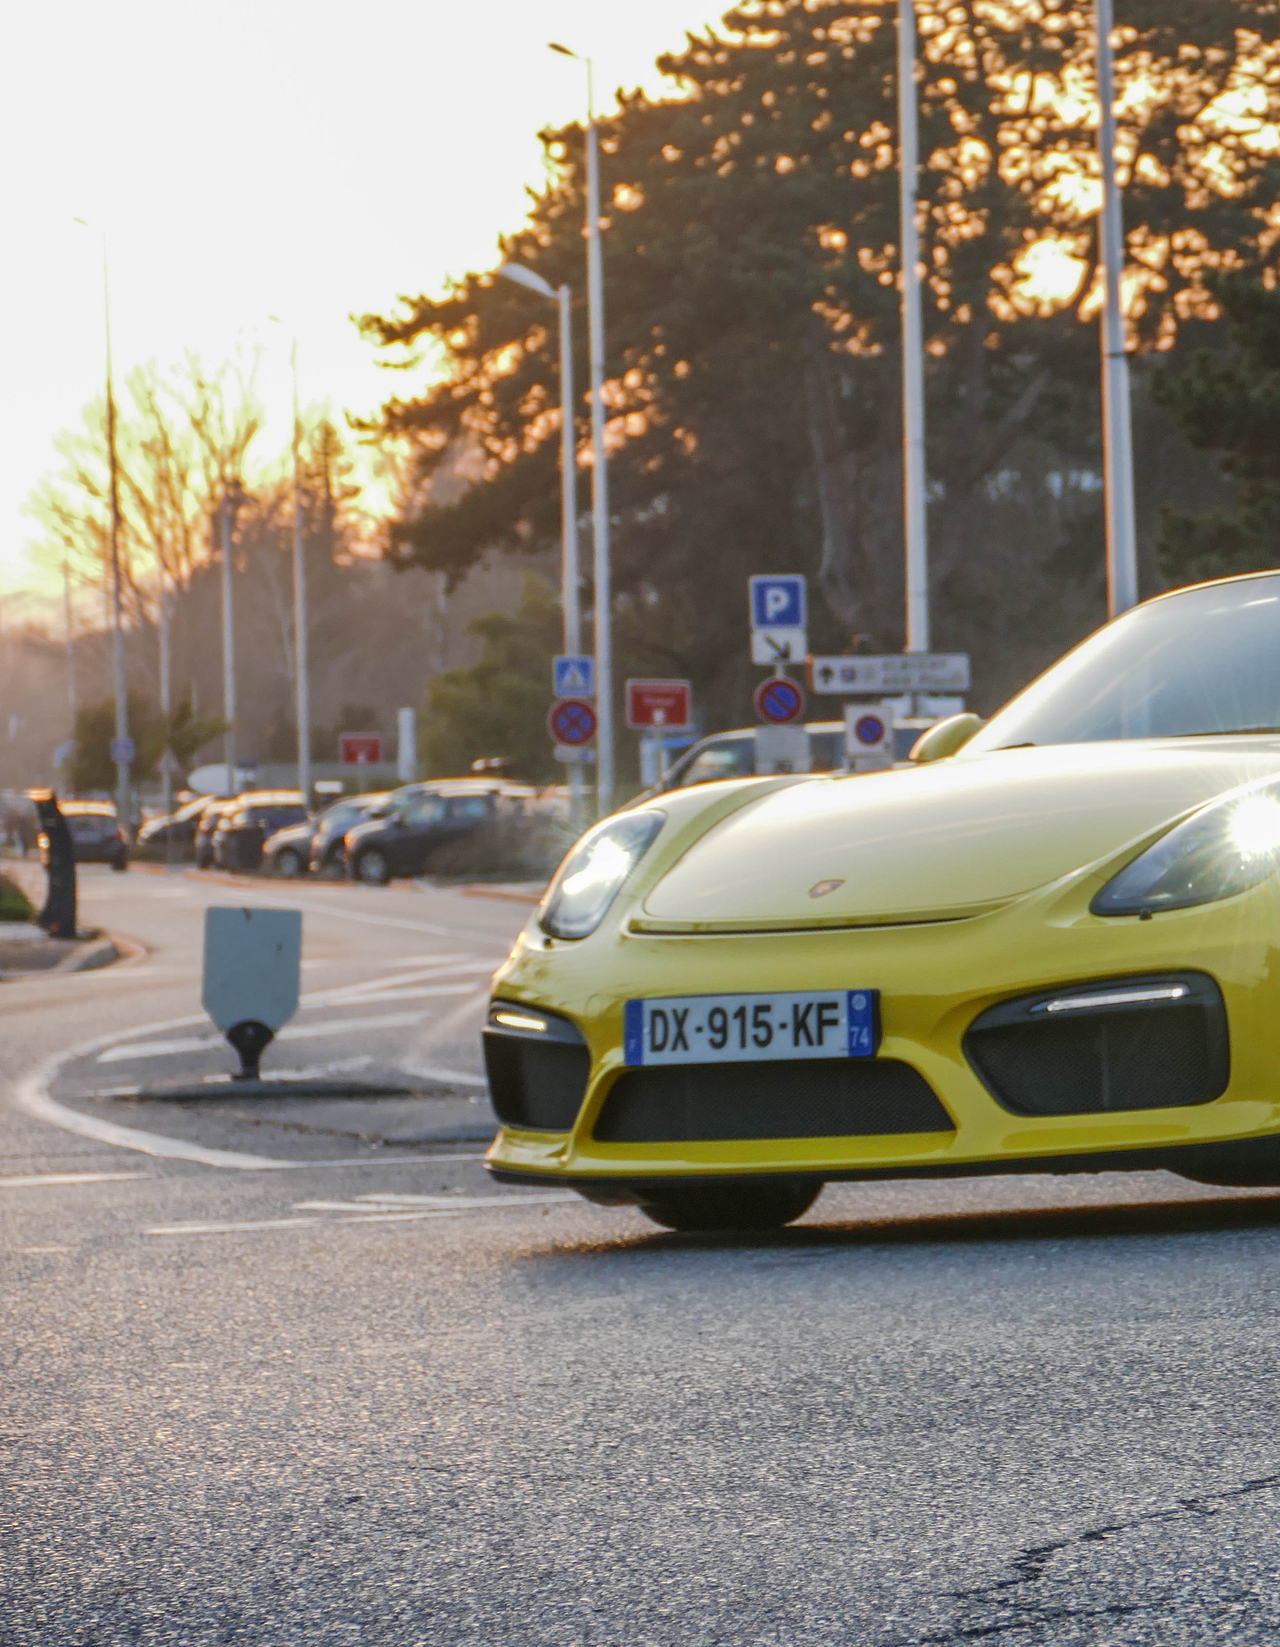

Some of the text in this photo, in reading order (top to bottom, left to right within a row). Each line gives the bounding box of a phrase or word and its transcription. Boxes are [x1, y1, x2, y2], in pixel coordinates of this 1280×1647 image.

[766, 588, 788, 619] P
[650, 1002, 839, 1052] DX-915-KF
[850, 1026, 869, 1047] 74
